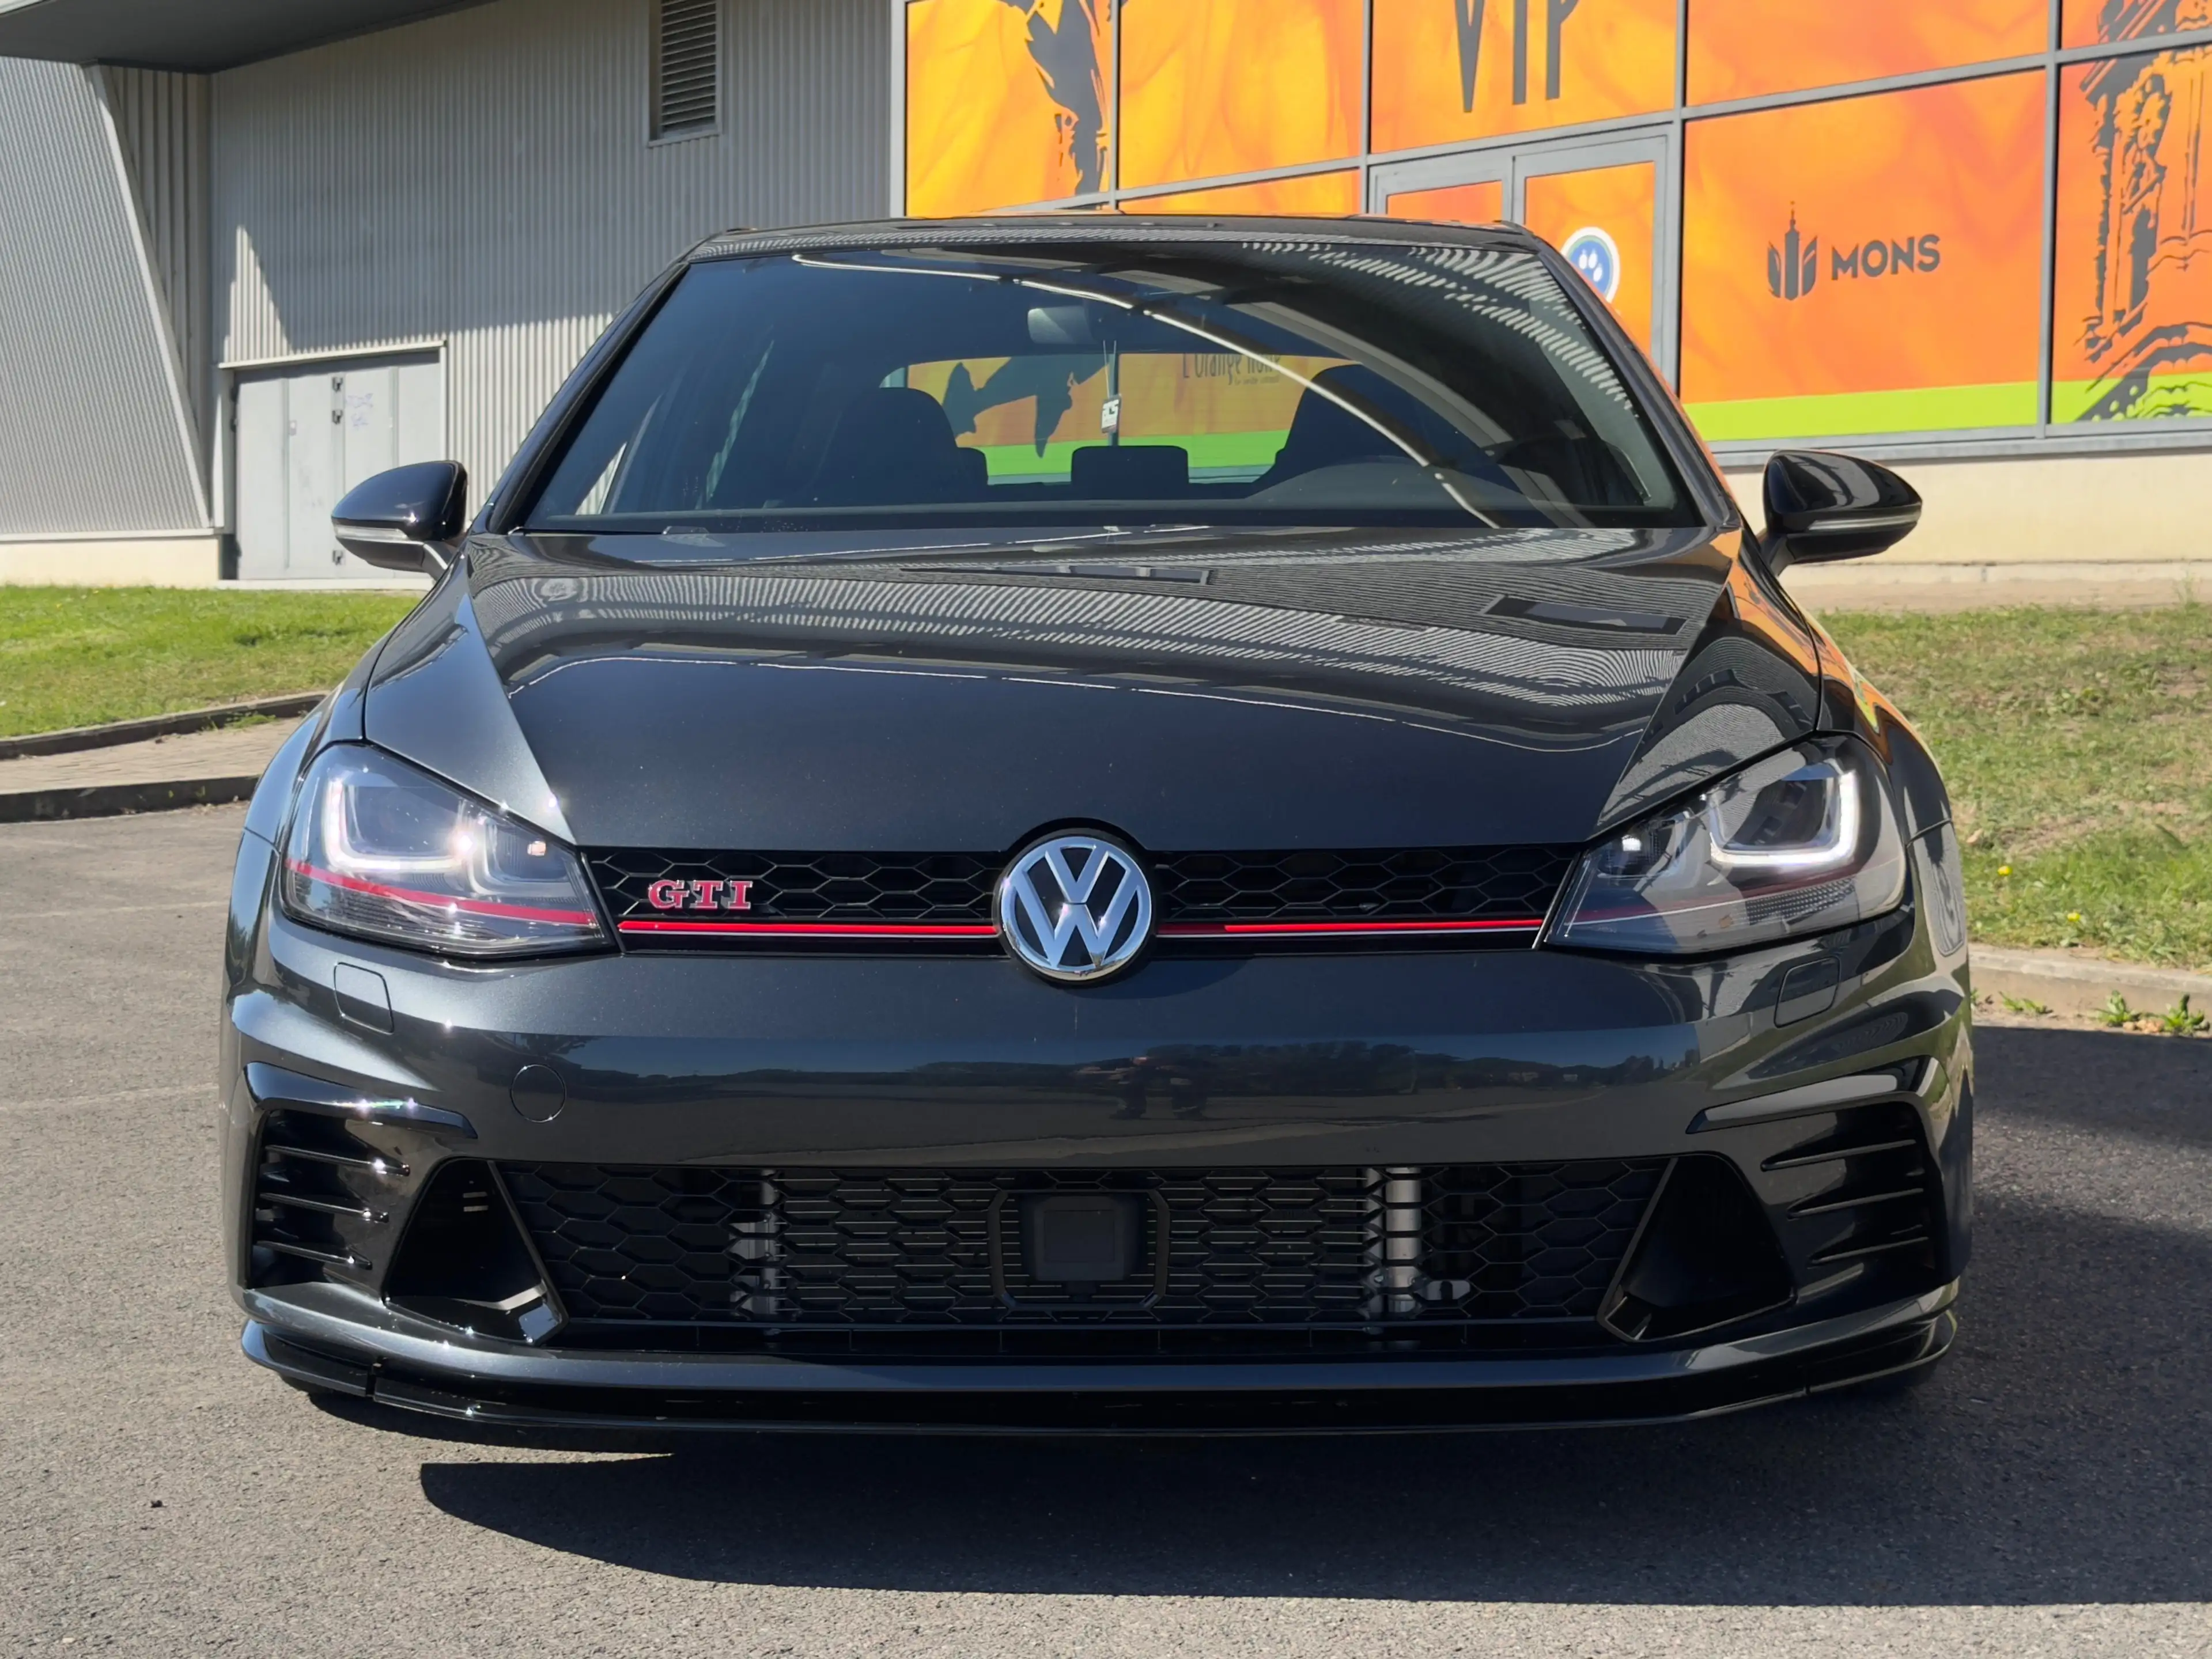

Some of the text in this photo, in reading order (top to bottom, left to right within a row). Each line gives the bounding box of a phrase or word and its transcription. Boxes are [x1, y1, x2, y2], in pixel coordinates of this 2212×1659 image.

[1454, 0, 1580, 113] VIP
[1831, 233, 1941, 281] MONS
[648, 879, 753, 909] GTI
[1004, 836, 1148, 978] VW
